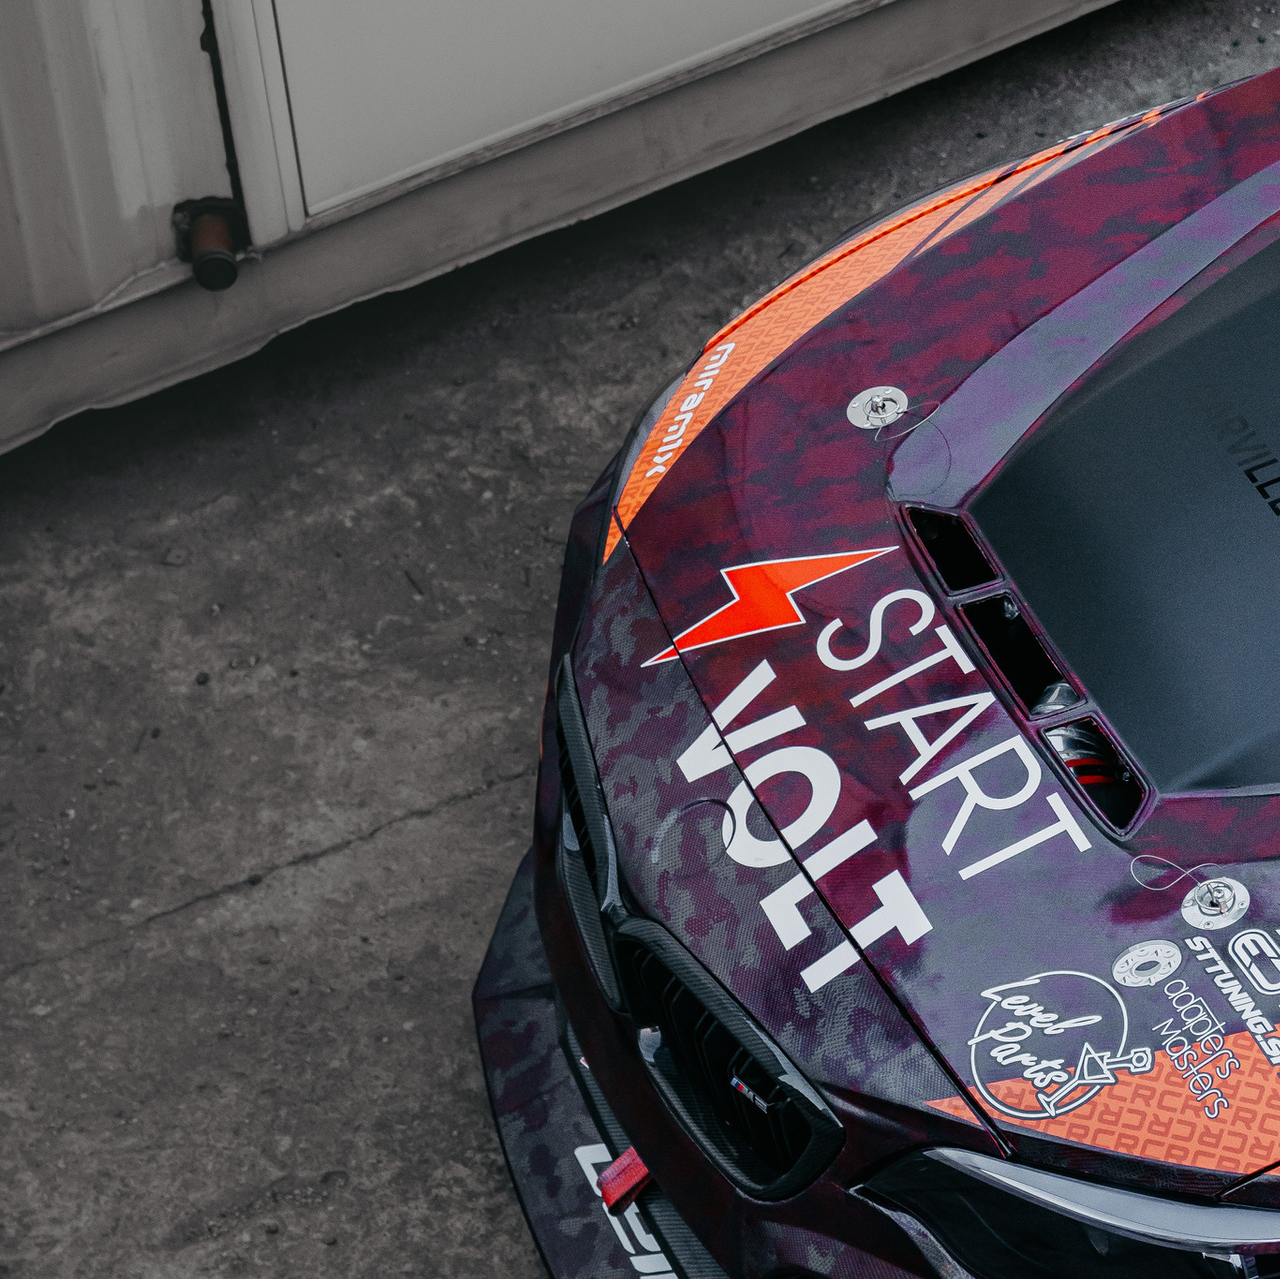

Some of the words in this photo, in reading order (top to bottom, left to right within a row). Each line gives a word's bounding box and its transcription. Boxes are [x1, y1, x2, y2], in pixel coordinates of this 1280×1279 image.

[816, 588, 1093, 881] START
[675, 658, 934, 994] VOLT
[967, 1021, 1069, 1088] Parts
[980, 978, 1103, 1035] Level
[1163, 978, 1240, 1079] adapters
[1151, 1017, 1229, 1118] Masters
